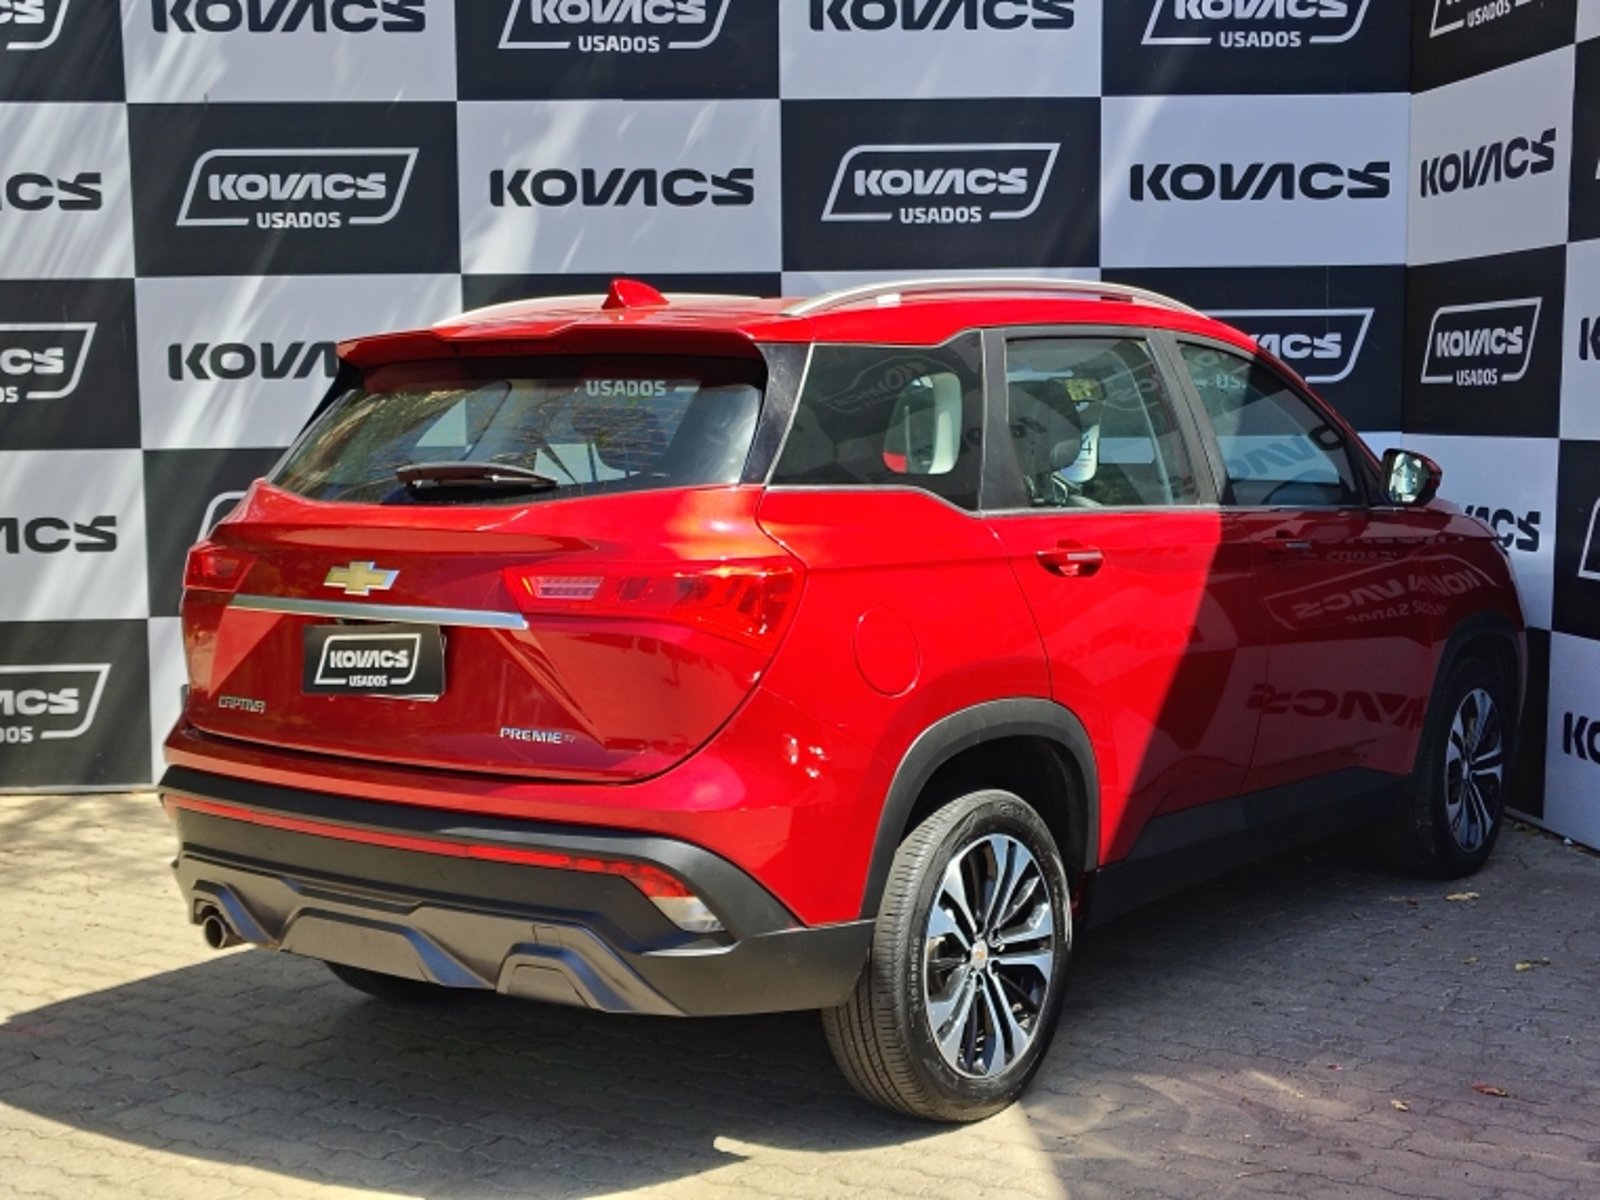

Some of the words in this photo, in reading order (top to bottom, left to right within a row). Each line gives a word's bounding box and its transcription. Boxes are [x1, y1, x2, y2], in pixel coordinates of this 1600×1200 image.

[152, 0, 425, 32] KOVACS
[531, 0, 706, 23] KOVACS
[810, 0, 1074, 31] KOVACS
[1174, 0, 1348, 19] KOVACS
[1467, 0, 1511, 28] USADOS
[578, 35, 660, 53] USADOS
[1219, 31, 1302, 48] USADOS
[1420, 128, 1556, 197] KOVACS
[208, 173, 387, 201] KOVACS
[490, 168, 754, 207] KOVACS
[854, 168, 1028, 196] KOVACS
[1130, 162, 1390, 201] KOVACS
[256, 211, 341, 229] USADOS
[900, 206, 982, 224] USADOS
[1436, 326, 1523, 358] KOVACS
[586, 380, 667, 396] USADOS
[1456, 368, 1498, 386] USADOS
[329, 650, 409, 668] KOVACS
[348, 675, 388, 687] USADOS
